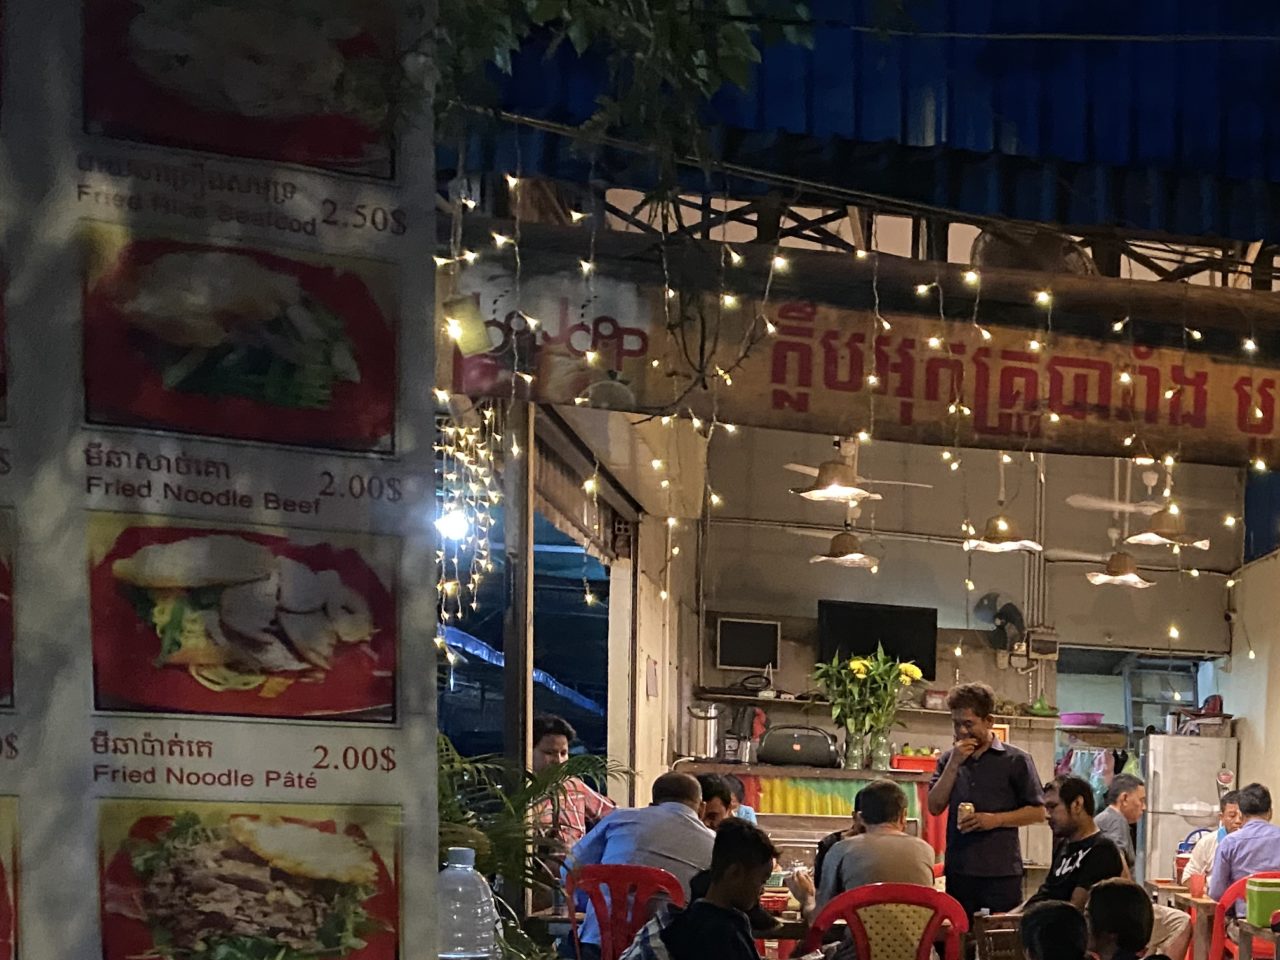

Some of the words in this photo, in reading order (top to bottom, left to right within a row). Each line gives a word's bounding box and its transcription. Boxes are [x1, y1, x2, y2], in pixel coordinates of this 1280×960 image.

[77, 184, 141, 211] Fried
[321, 198, 407, 235] 2.50$
[86, 476, 152, 499] Fried
[163, 481, 253, 510] Noodle
[264, 492, 321, 515] Beef
[319, 471, 403, 503] 2.00$
[313, 744, 397, 772] 2.00$
[93, 765, 156, 784] Fried
[166, 766, 254, 787] Noodle
[265, 769, 317, 789] Pâté
